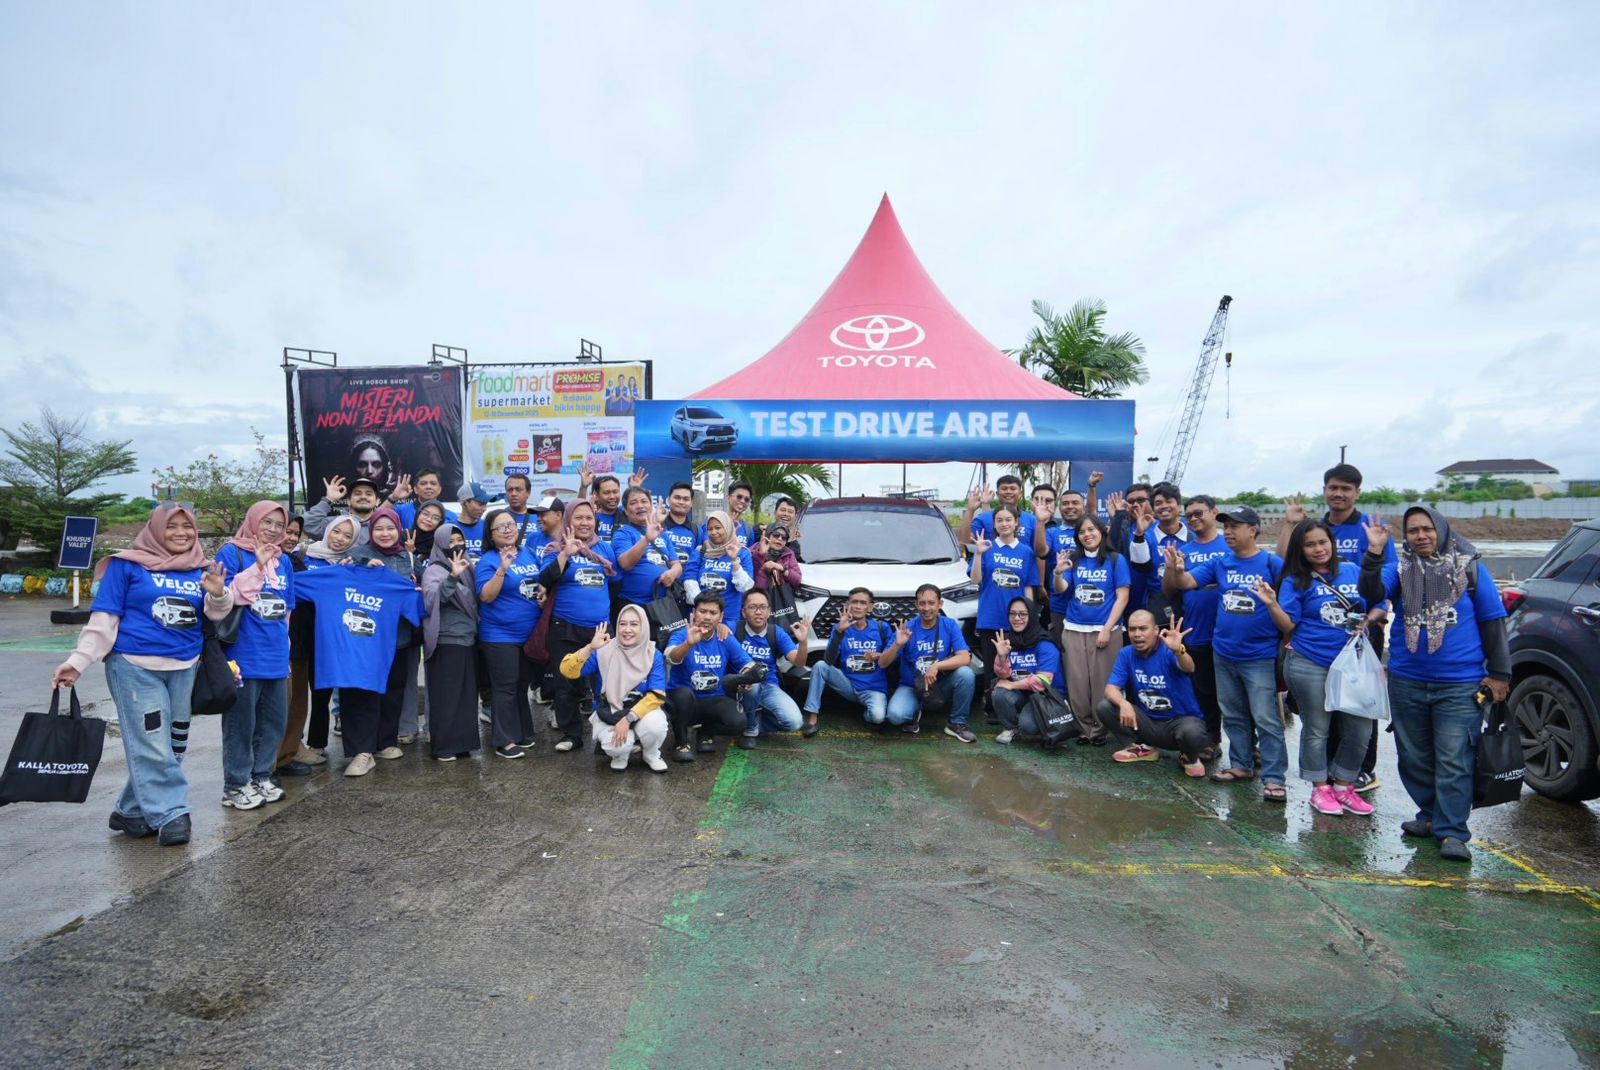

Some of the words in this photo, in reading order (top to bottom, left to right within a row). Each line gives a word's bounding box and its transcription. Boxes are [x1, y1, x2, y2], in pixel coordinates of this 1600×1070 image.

[816, 355, 936, 369] TOYOTA
[478, 369, 551, 393] foodmart
[555, 373, 601, 384] PROMISE
[340, 386, 415, 410] MISTERI
[477, 394, 551, 408] supermarket
[316, 411, 359, 429] NONI
[360, 403, 441, 428] BELANDA
[750, 411, 827, 437] TEST
[834, 411, 935, 437] DRIVE
[942, 411, 1036, 437] AREA
[66, 535, 92, 543] KHUSUS
[1059, 537, 1076, 545] VEL
[1336, 539, 1359, 549] LOZ
[993, 556, 1023, 565] VELOZ
[1076, 570, 1107, 578] VELOZ
[344, 591, 383, 608] VELOZ
[741, 643, 771, 656] VELOZ
[847, 640, 877, 649] VELOZ
[917, 640, 944, 651] VELZ
[694, 654, 721, 664] VELOZ
